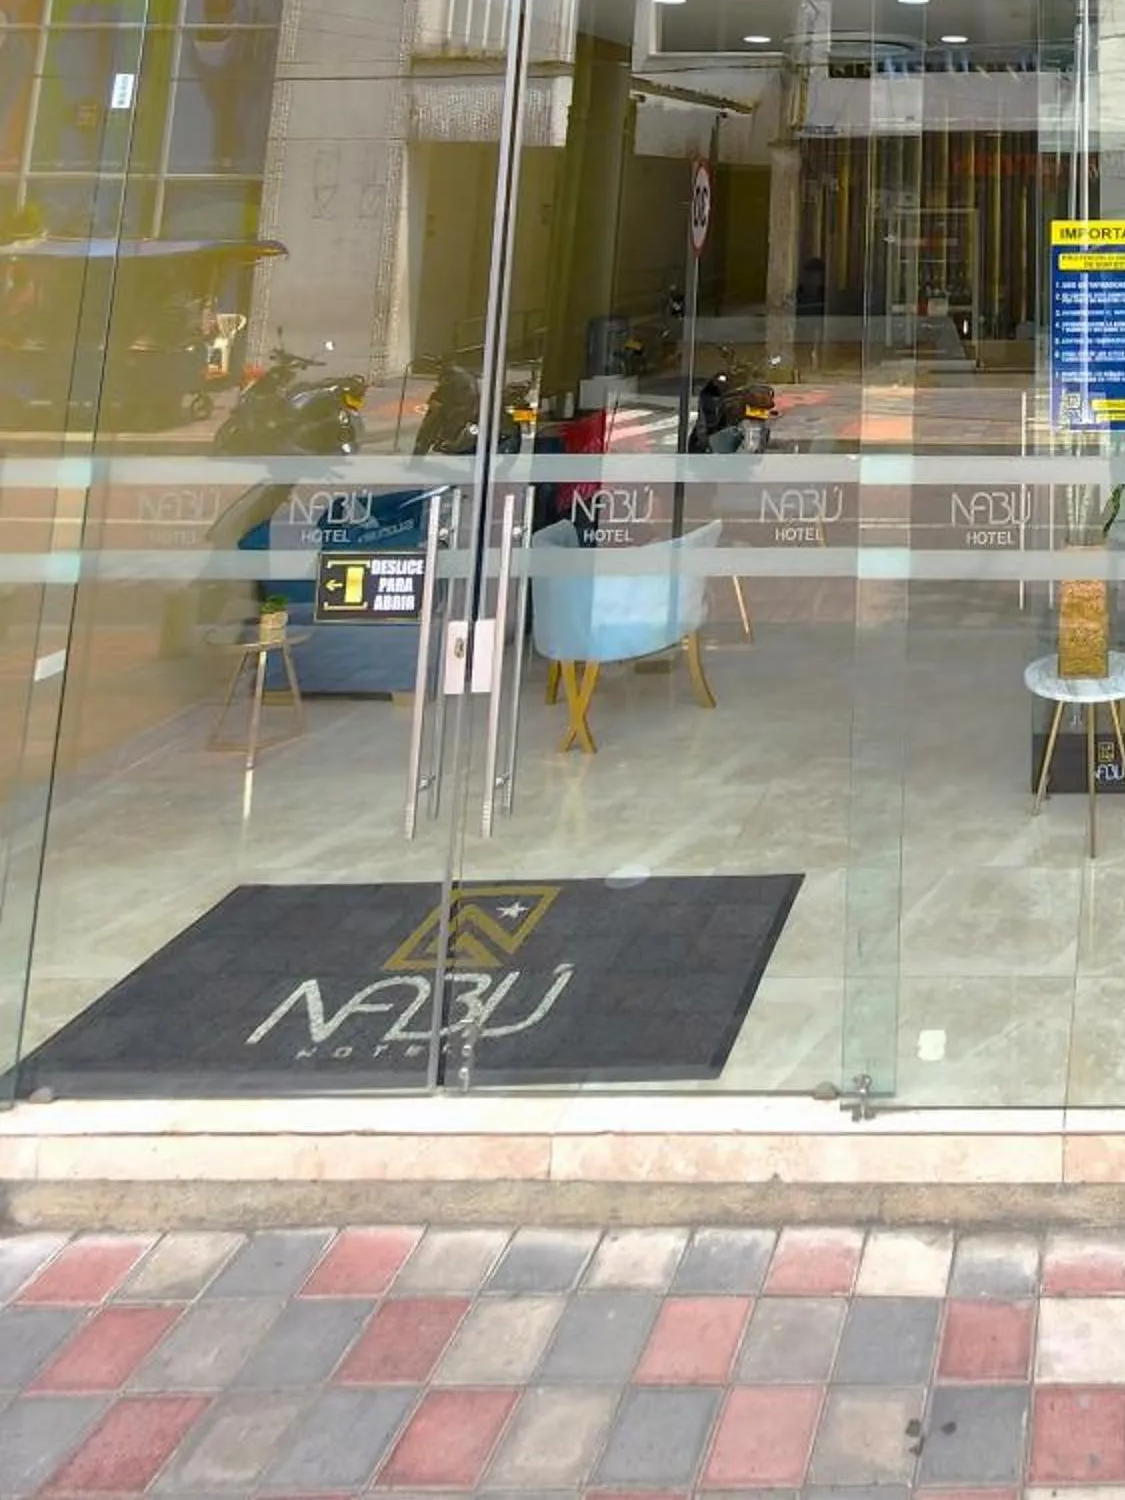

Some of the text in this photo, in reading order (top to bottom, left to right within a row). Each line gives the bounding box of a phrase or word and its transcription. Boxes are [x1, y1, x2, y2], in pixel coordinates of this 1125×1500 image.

[570, 486, 654, 523] NABÚ
[301, 529, 351, 543] HOTEL
[583, 528, 634, 543] HOTEL
[774, 527, 824, 542] HOTEL
[966, 531, 1014, 545] HOTEL
[371, 559, 425, 575] DESLICE
[378, 577, 413, 592] PARA
[373, 595, 415, 610] ABRIR
